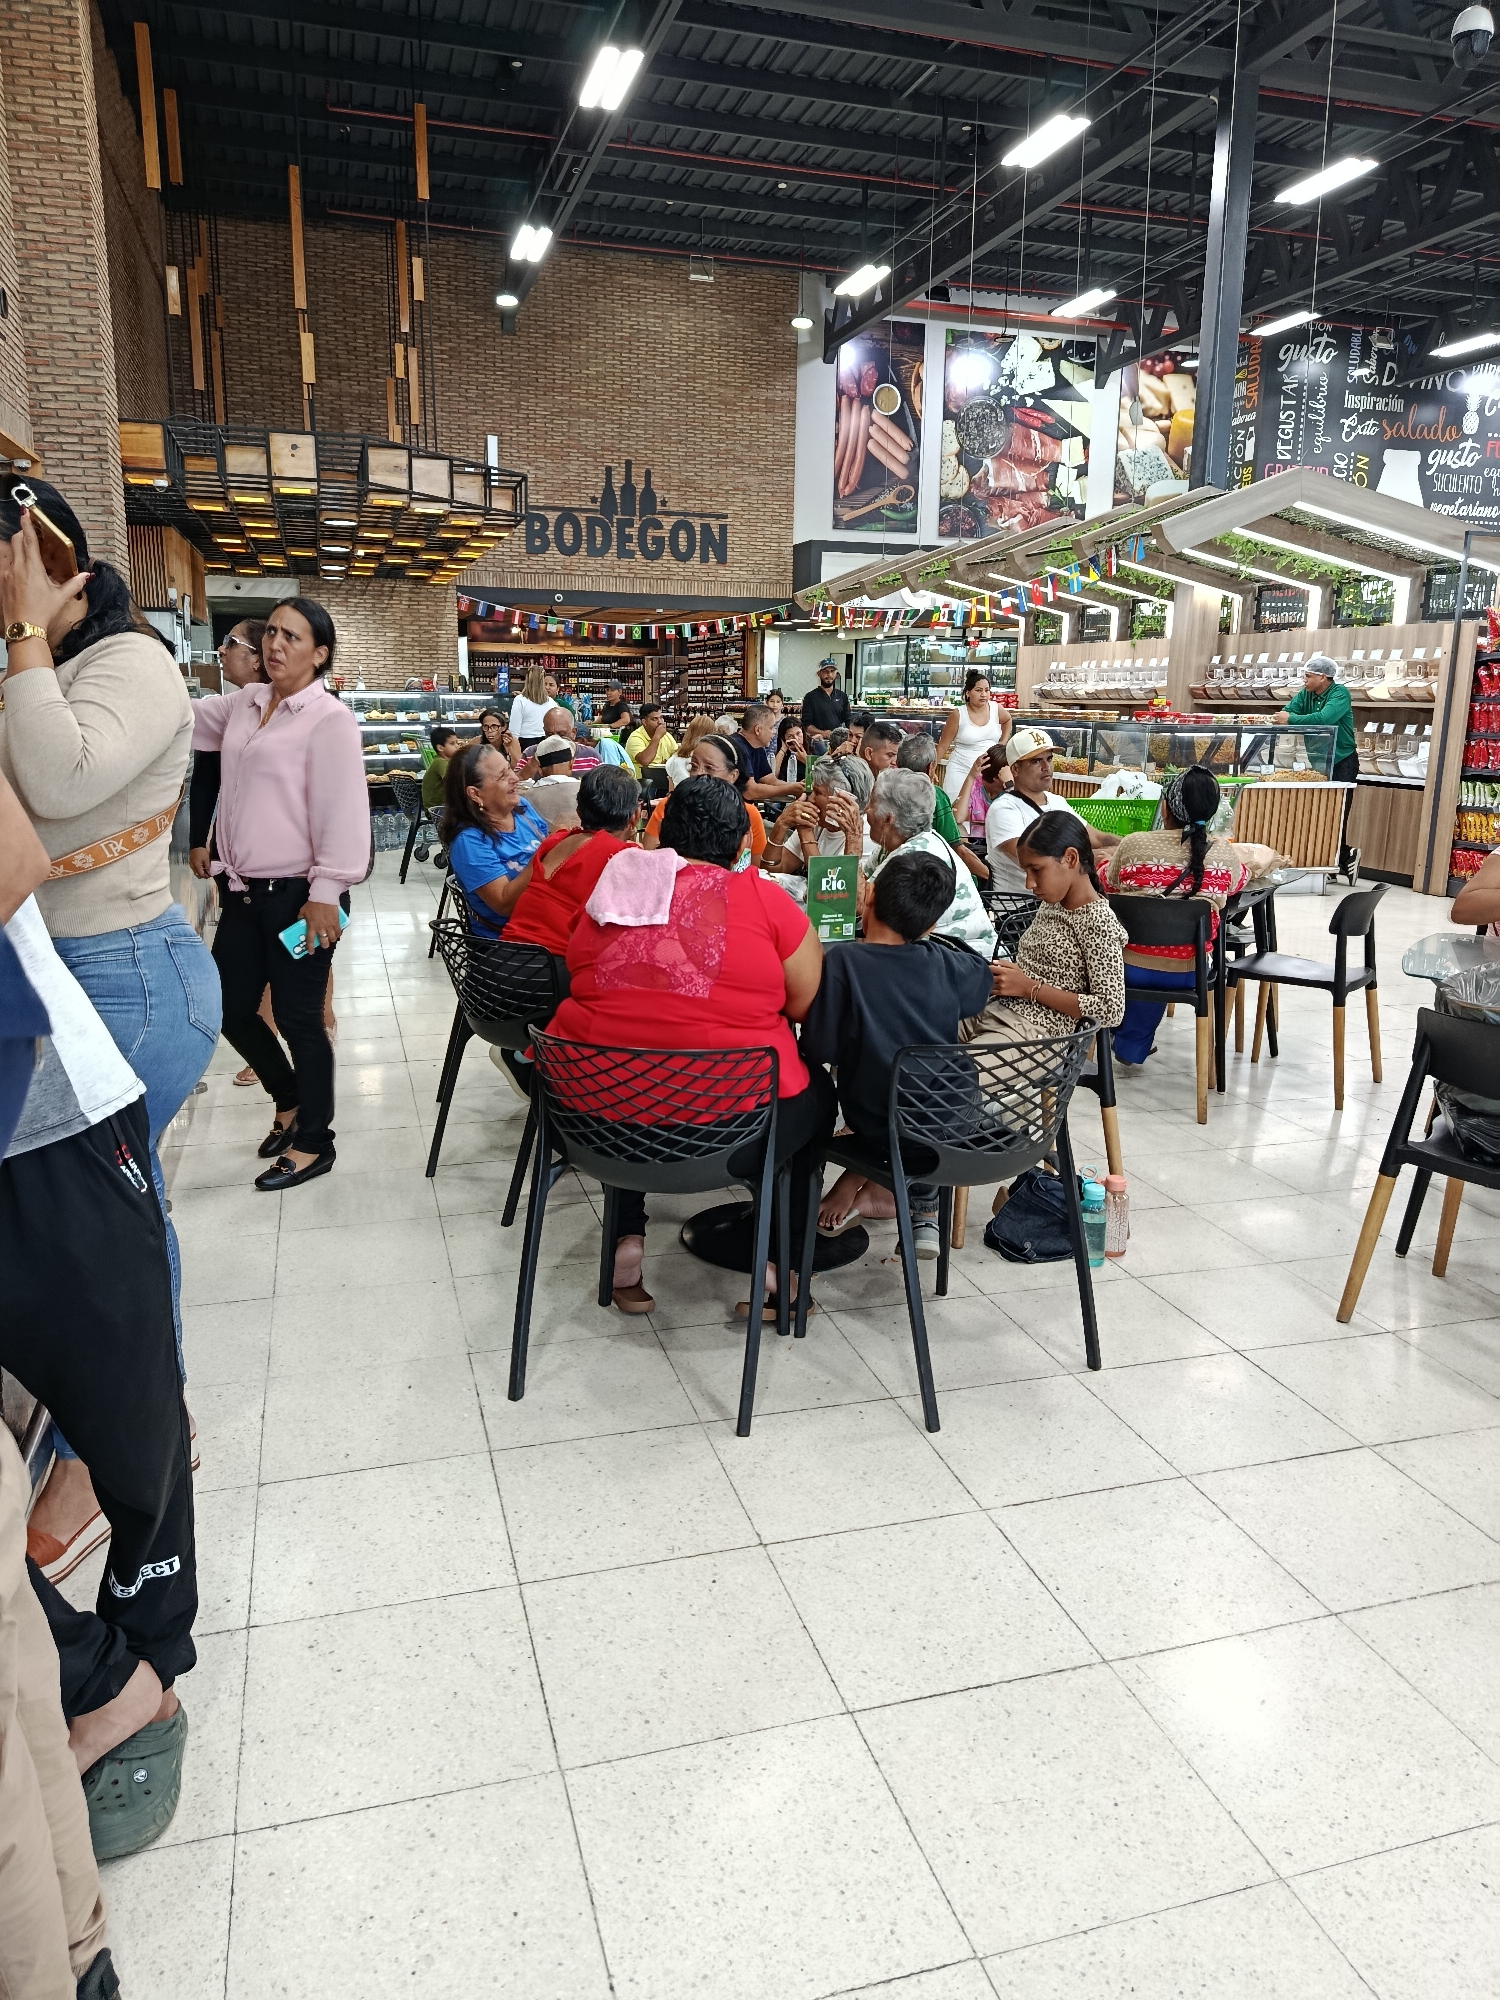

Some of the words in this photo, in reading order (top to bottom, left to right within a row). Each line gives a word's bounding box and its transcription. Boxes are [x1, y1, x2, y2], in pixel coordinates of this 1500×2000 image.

[1277, 332, 1339, 372] gusto
[1276, 373, 1299, 460] DEGUSTAR
[1308, 371, 1332, 454] equilibrio
[1344, 390, 1404, 413] Inspiración
[1382, 403, 1463, 443] salado
[1426, 437, 1483, 476] gusto
[1433, 472, 1483, 495] SUCULENTO
[526, 511, 728, 564] BODEGON
